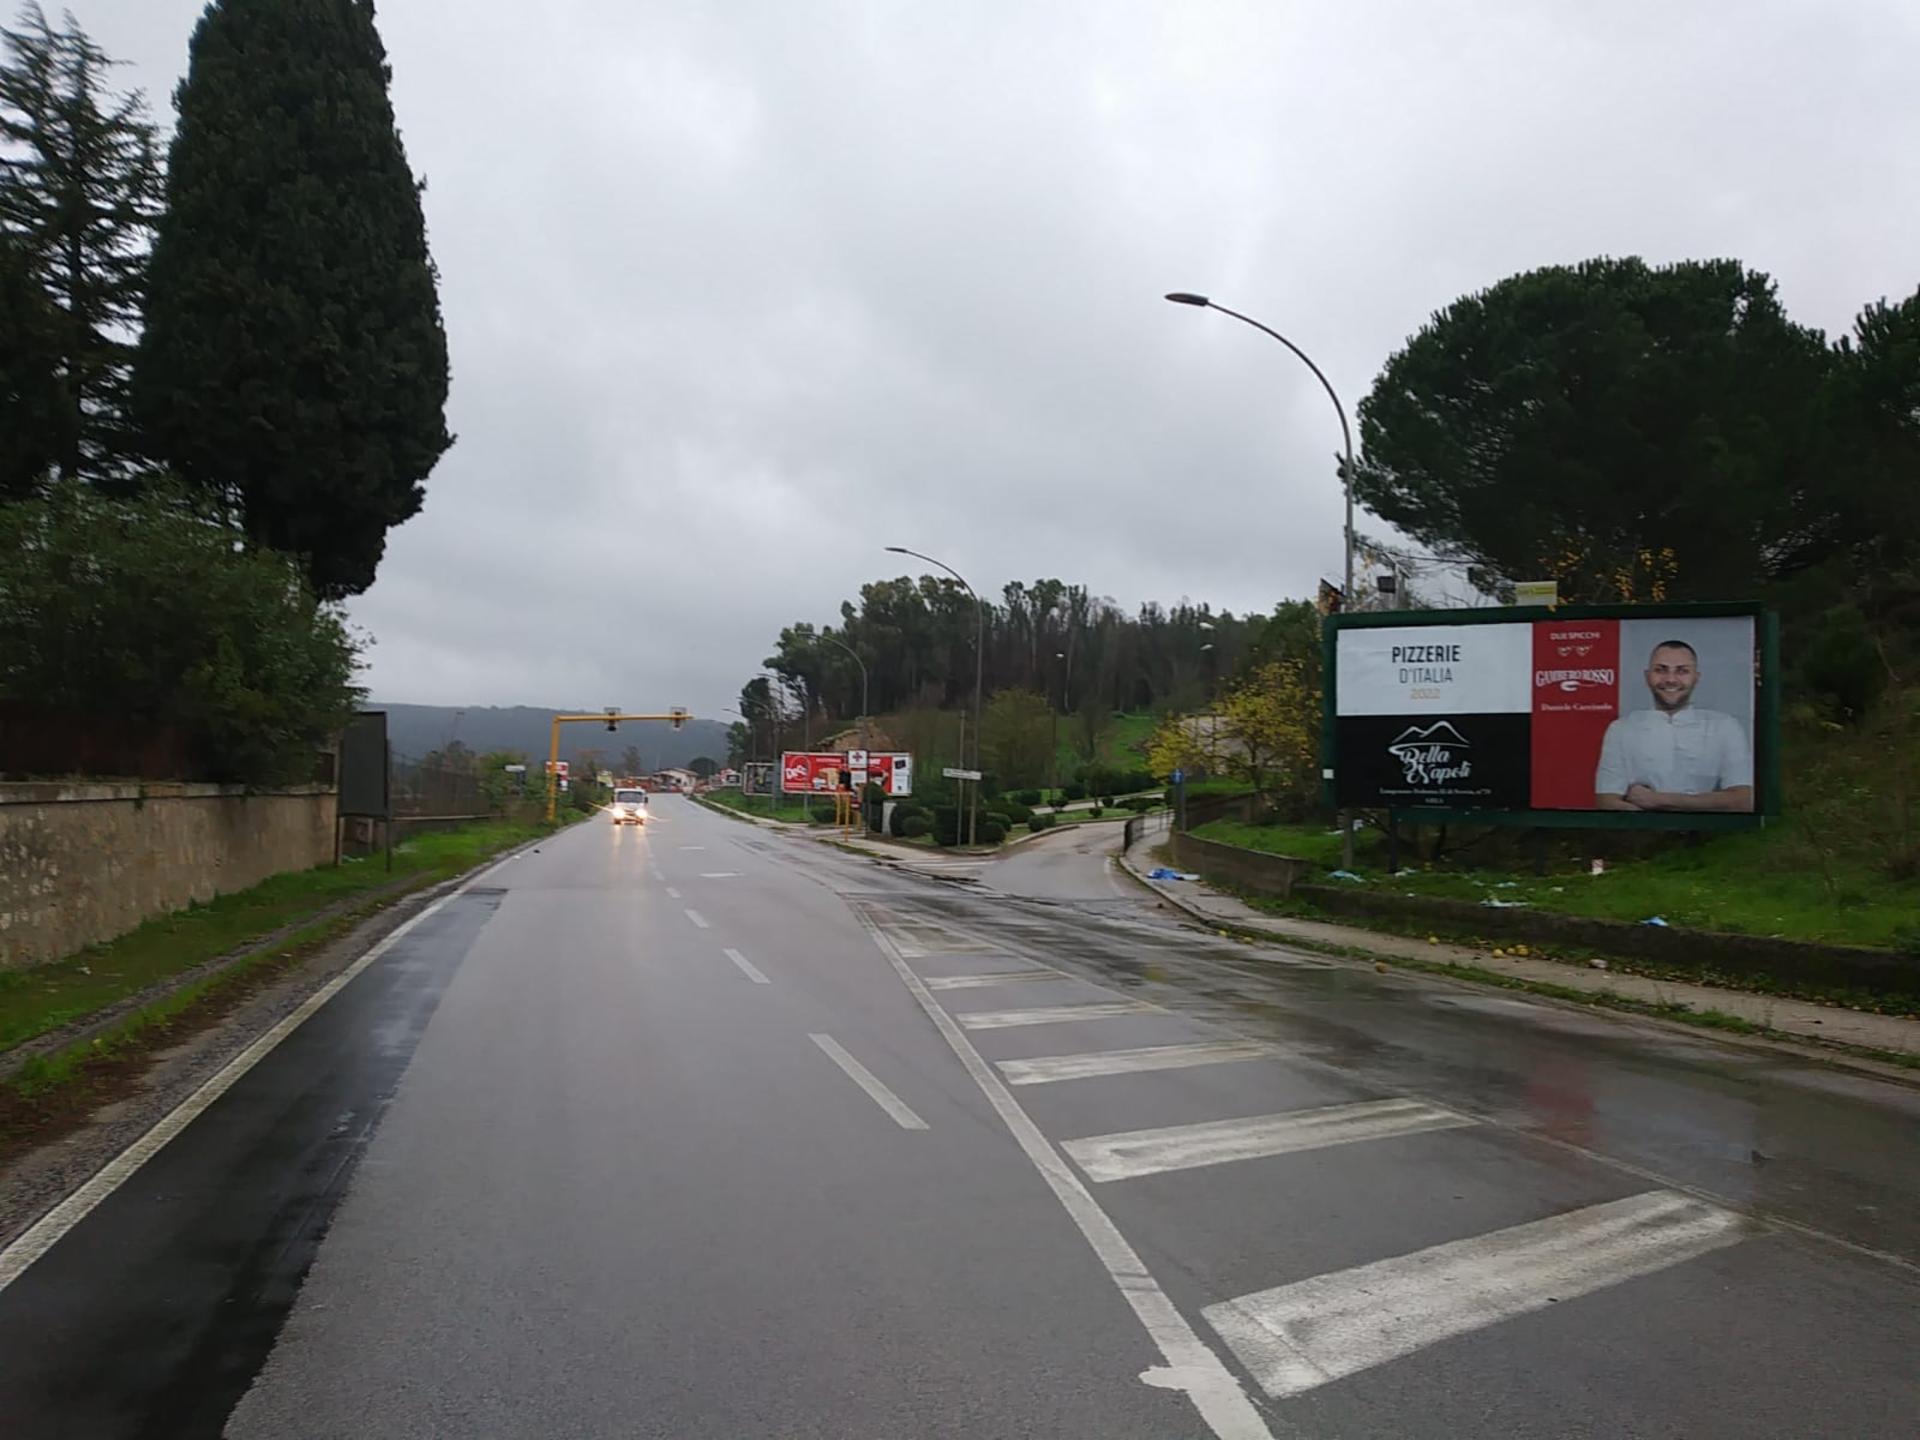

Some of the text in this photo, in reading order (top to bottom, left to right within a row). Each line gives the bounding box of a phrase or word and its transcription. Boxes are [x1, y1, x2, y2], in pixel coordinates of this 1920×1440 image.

[1392, 645, 1461, 663] PIZZERIE
[1399, 667, 1453, 683] D'ITALIA
[1581, 669, 1614, 685] ROSSO
[1401, 744, 1449, 774] Bella
[1406, 761, 1472, 784] Napoli
